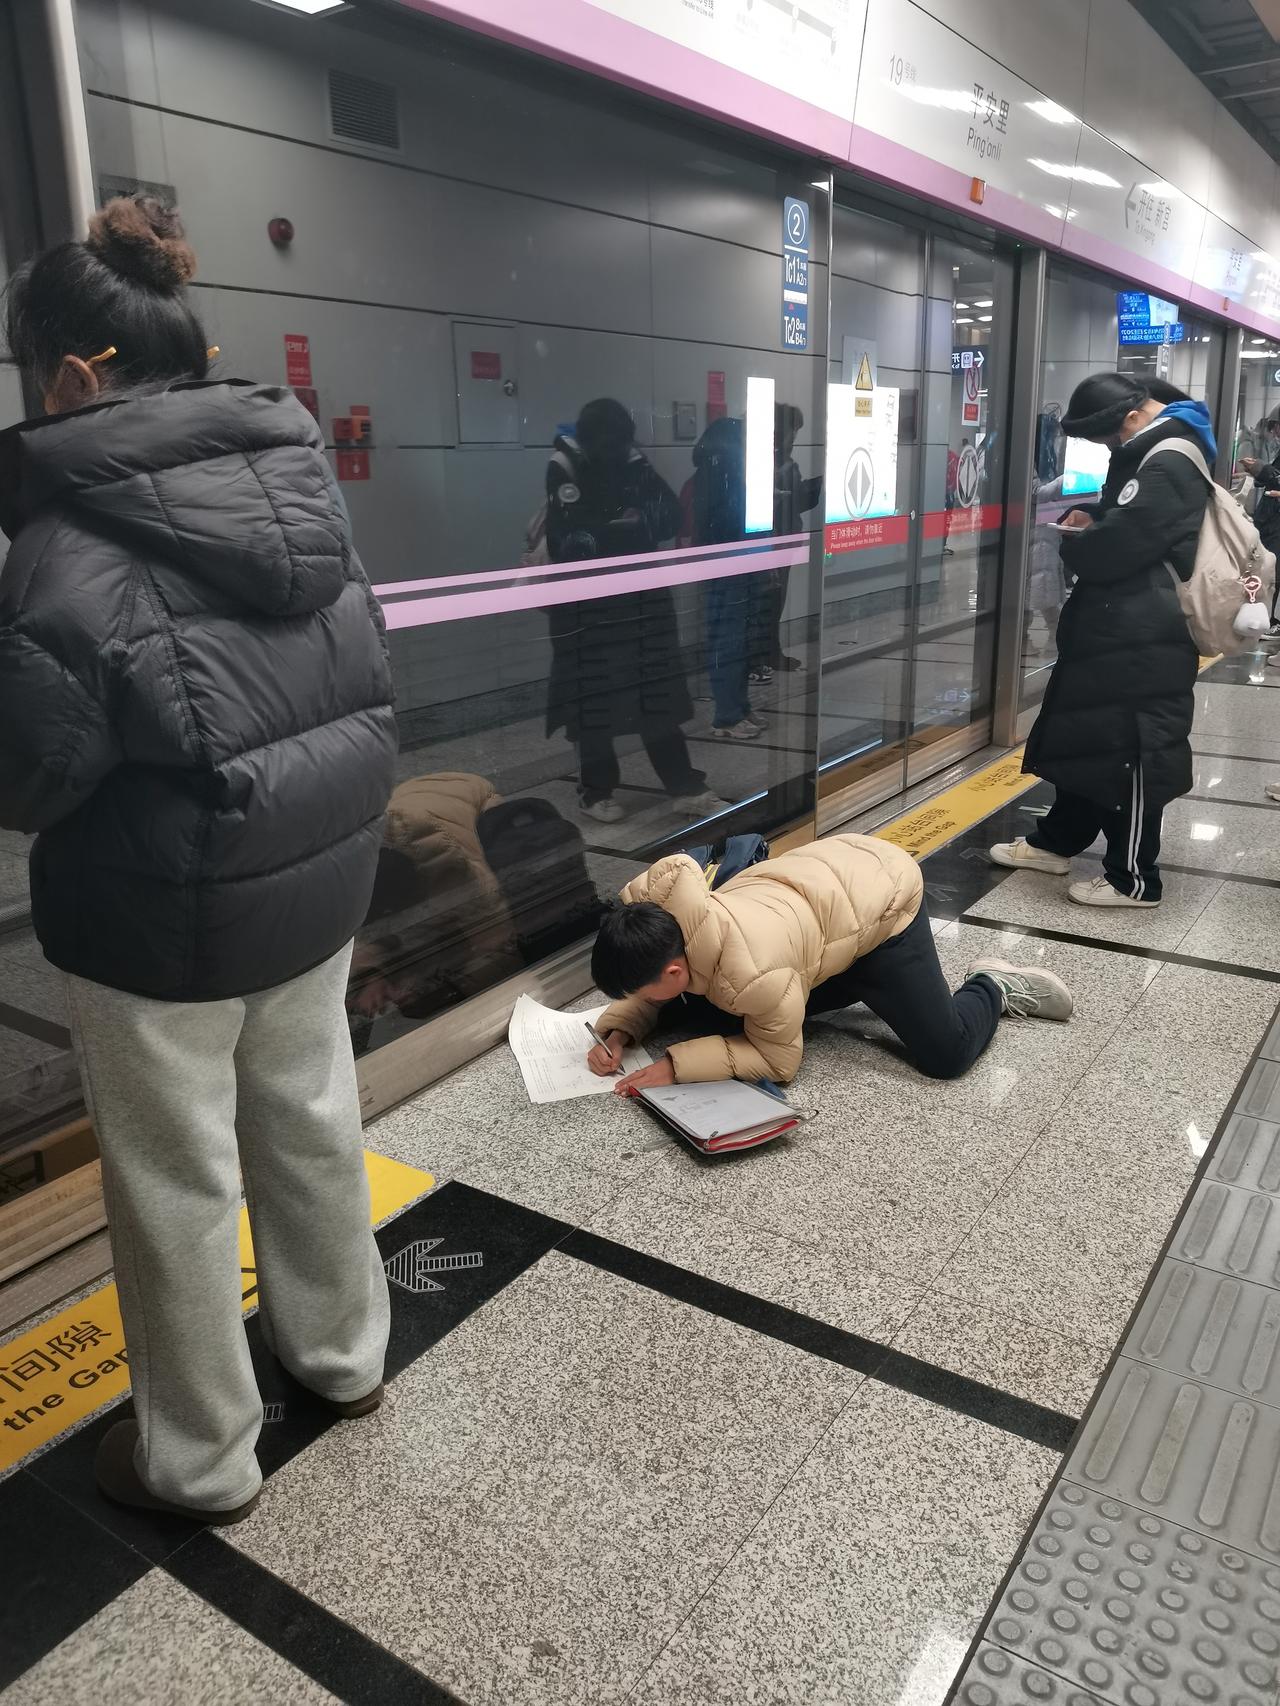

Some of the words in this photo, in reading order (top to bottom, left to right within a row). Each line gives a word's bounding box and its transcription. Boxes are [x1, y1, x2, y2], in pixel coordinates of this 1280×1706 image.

[970, 83, 1010, 135] 平安里
[792, 213, 801, 236] 2
[3, 1394, 65, 1431] the
